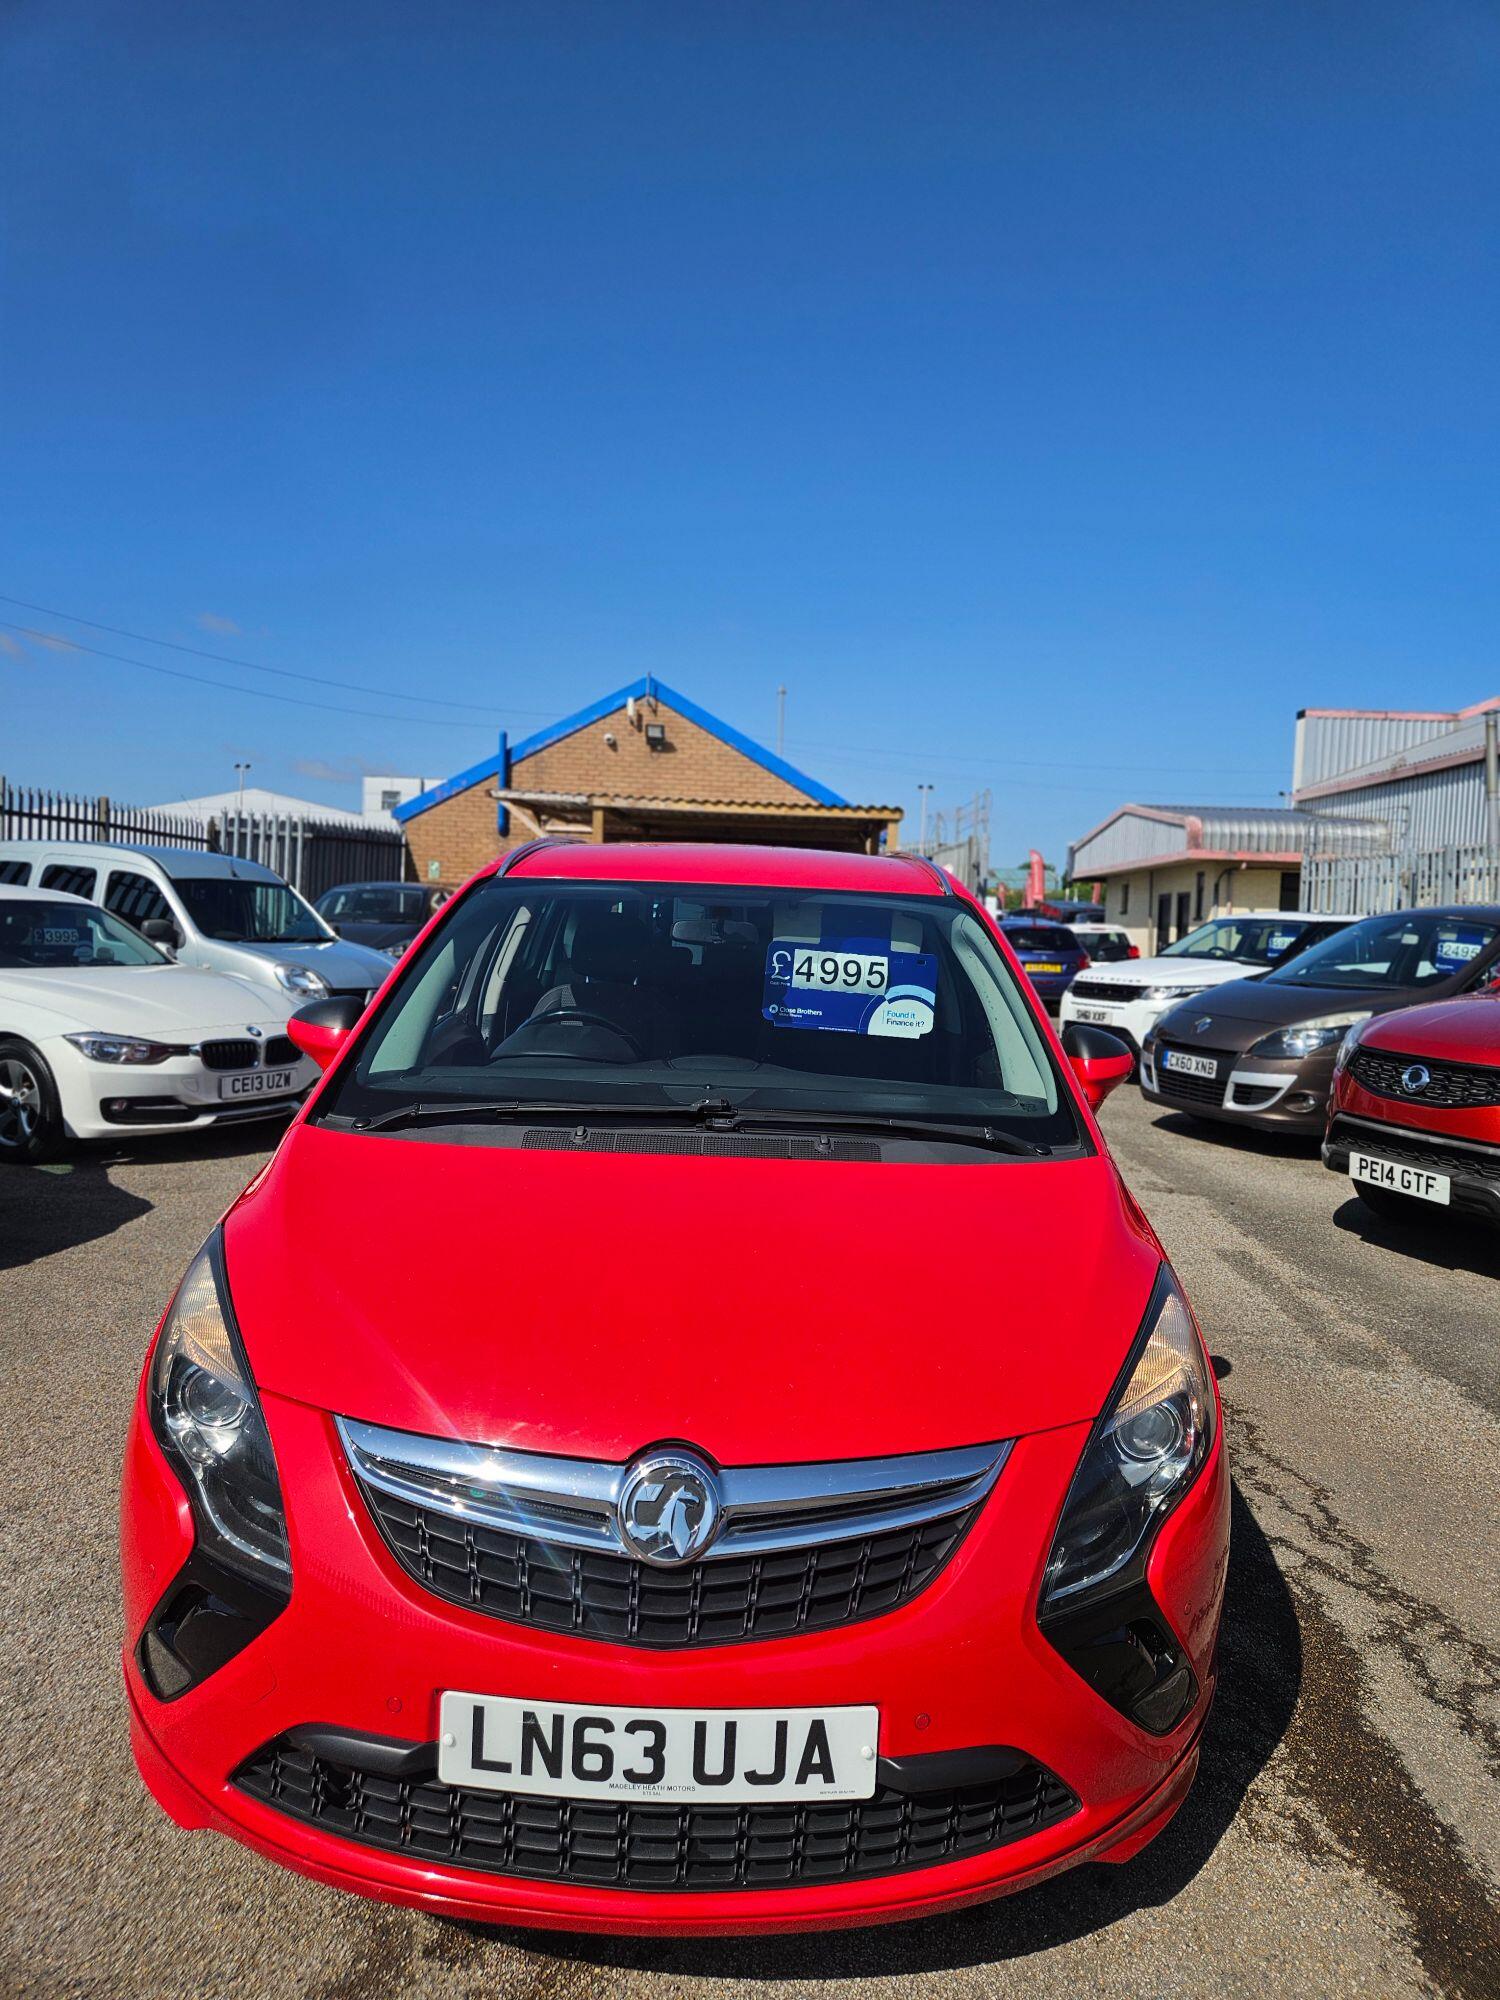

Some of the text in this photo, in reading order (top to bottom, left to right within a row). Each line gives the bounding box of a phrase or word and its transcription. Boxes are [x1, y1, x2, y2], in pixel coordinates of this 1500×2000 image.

[797, 1007, 823, 1016] Brothers
[887, 1010, 910, 1019] Found
[887, 1018, 914, 1027] Finance
[1169, 1054, 1192, 1071] CX60
[1194, 1059, 1214, 1075] XNB
[232, 1072, 292, 1094] CE13 UZW
[1359, 1157, 1437, 1196] PE14 GTF
[470, 1705, 837, 1786] LN63 UJA
